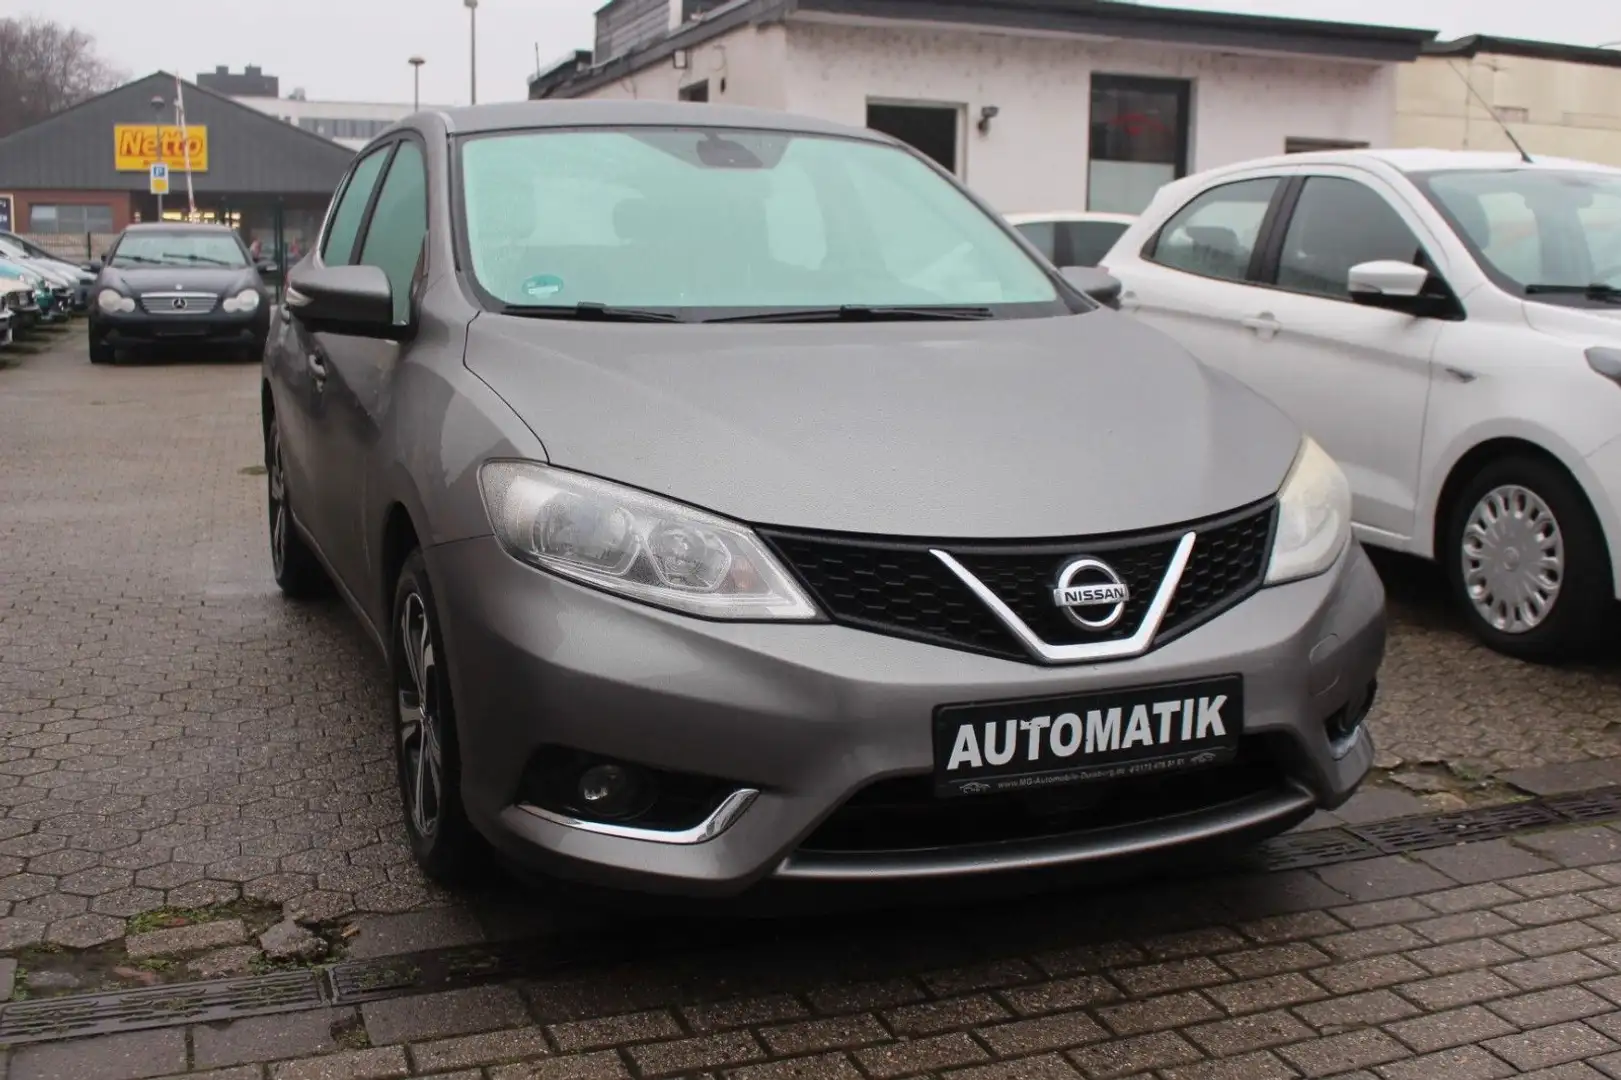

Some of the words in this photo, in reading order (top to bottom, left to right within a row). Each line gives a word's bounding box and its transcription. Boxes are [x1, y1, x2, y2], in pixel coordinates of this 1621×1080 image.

[120, 130, 203, 157] Netto
[1064, 588, 1124, 602] NISSAN
[947, 695, 1228, 771] AUTOMATIK
